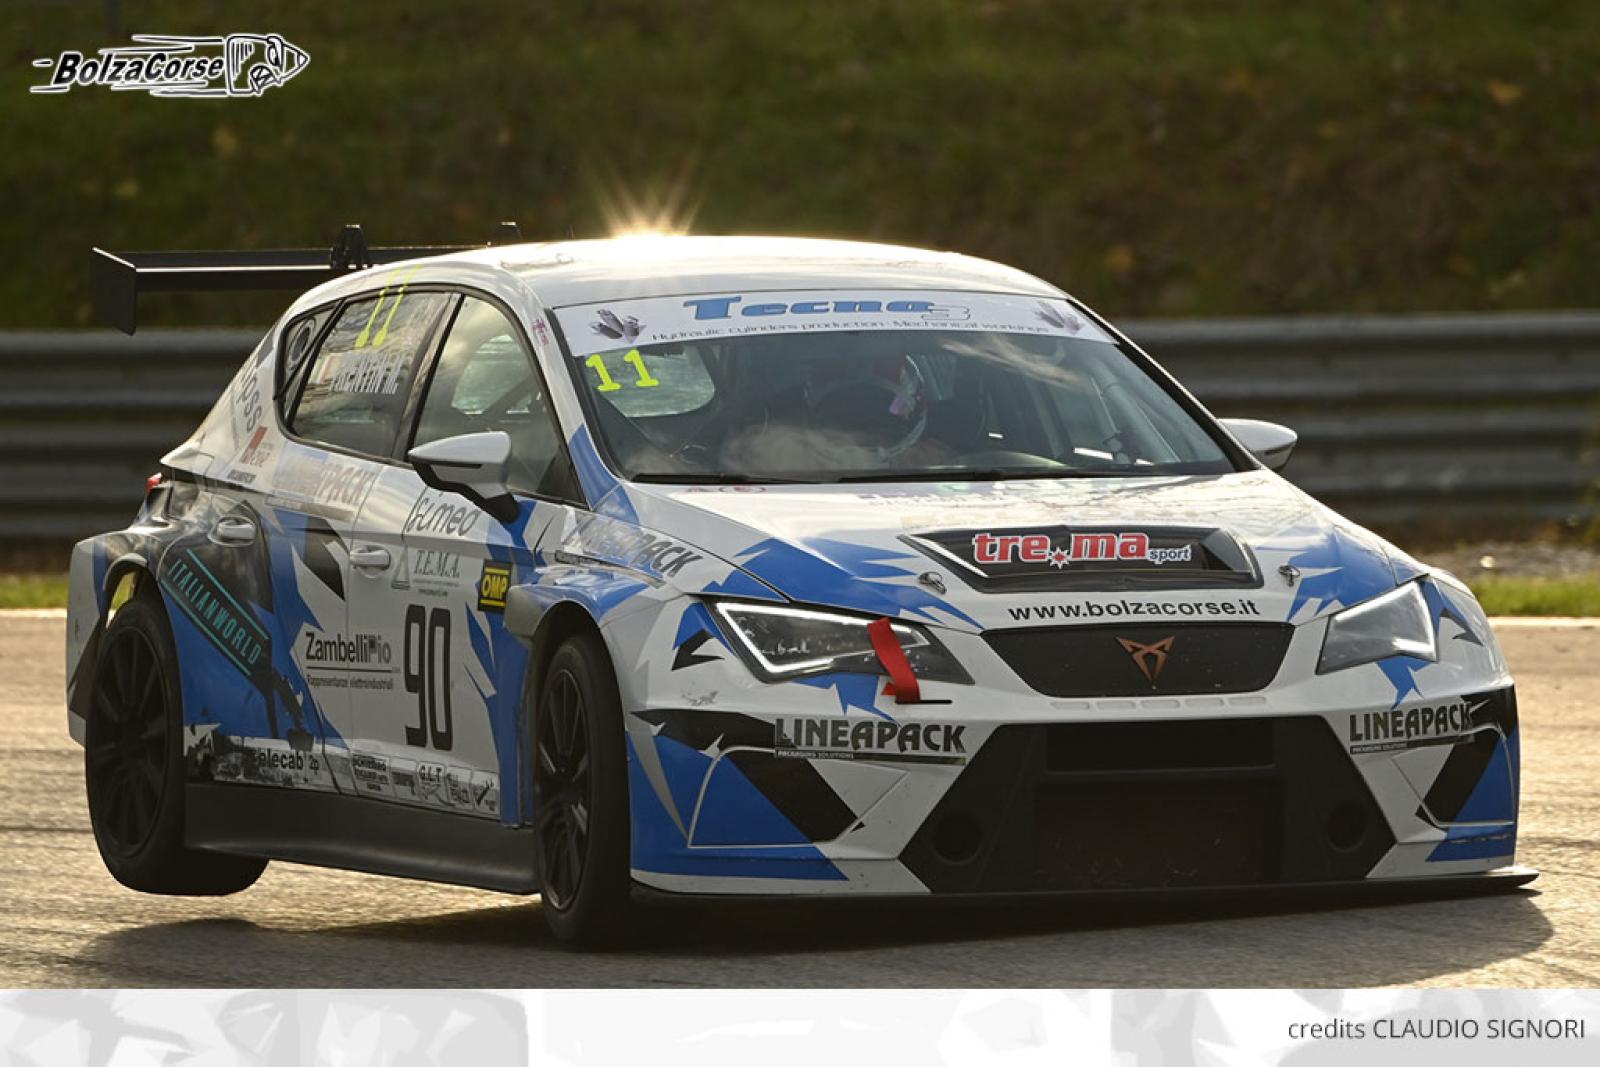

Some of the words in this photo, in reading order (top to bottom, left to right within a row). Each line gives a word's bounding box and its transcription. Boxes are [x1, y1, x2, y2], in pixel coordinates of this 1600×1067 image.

[585, 348, 659, 392] 11
[1150, 545, 1191, 564] sport
[482, 574, 509, 600] OMP
[168, 559, 262, 665] ITALIANWORLD
[1008, 599, 1261, 620] www.bolzacorse.it
[404, 603, 454, 752] 90
[776, 717, 967, 754] LINEAPACK
[1350, 701, 1474, 742] LINEAPACK
